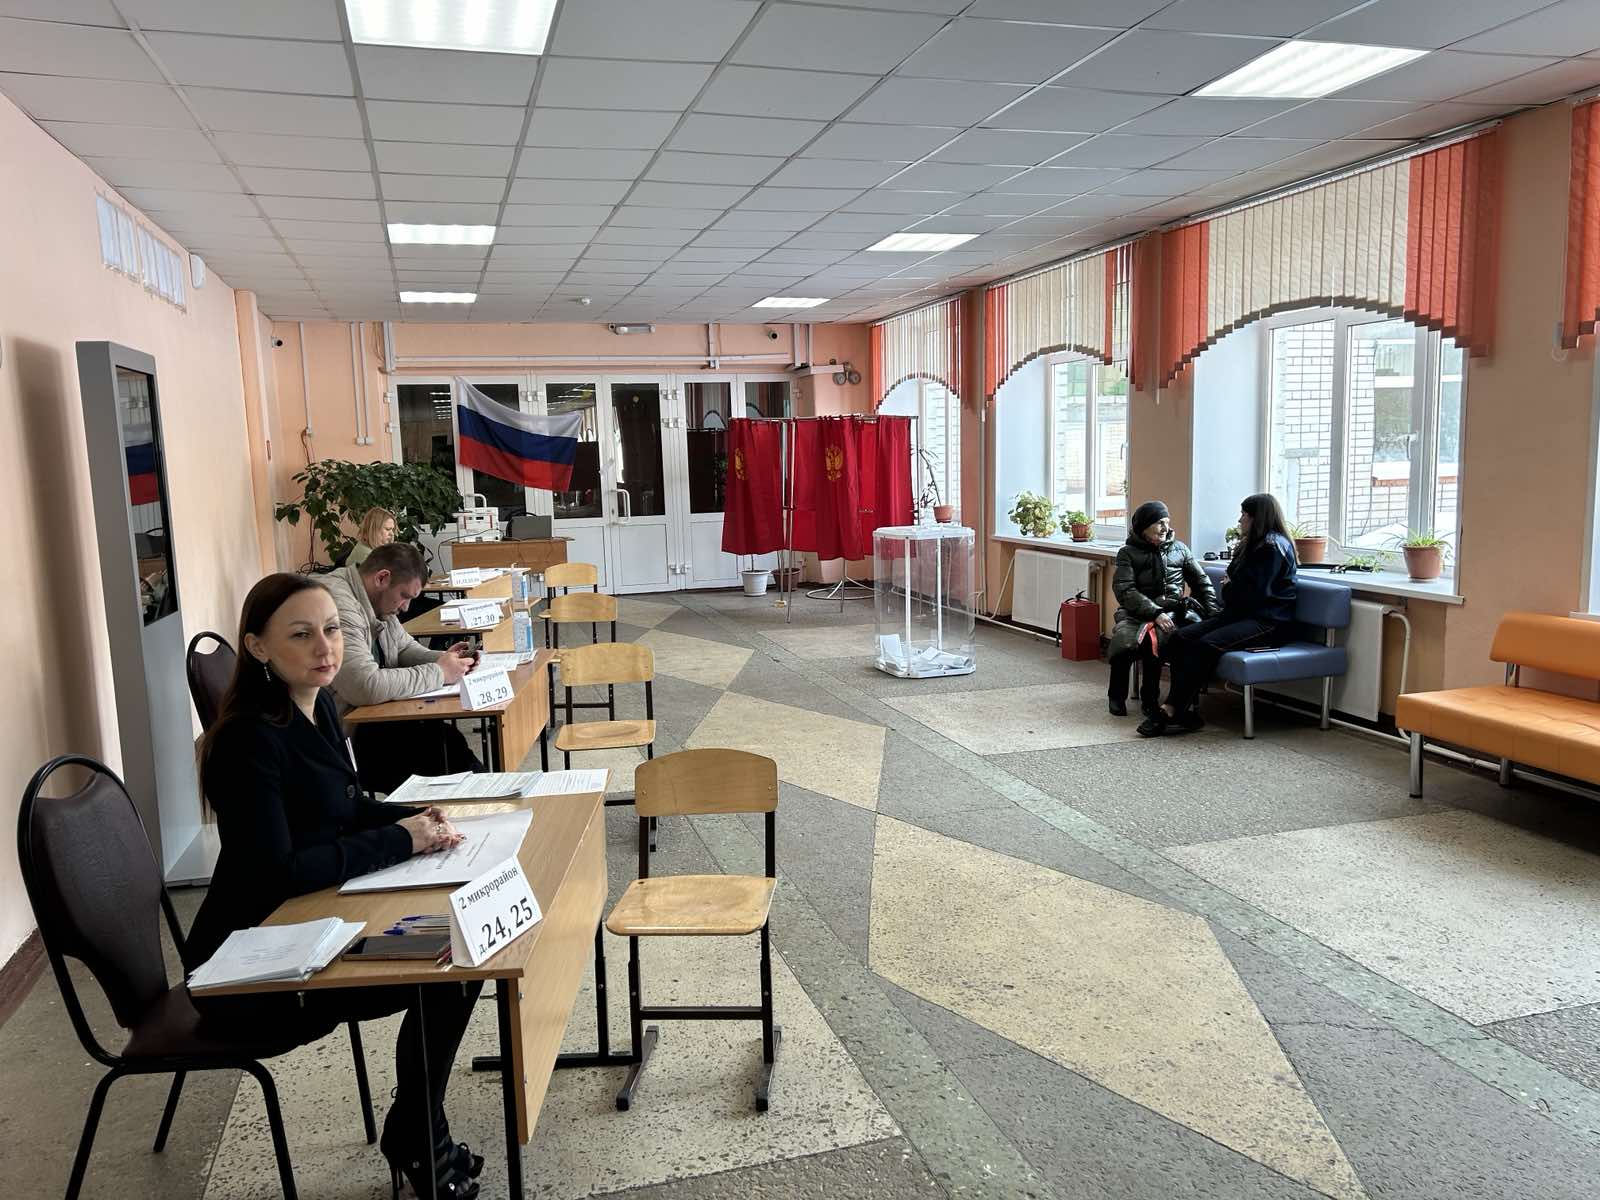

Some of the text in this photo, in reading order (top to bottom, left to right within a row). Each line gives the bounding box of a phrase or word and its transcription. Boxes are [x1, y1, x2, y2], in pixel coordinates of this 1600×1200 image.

[495, 686, 508, 699] 29
[459, 866, 518, 910] 2 микрорайон
[510, 897, 533, 929] 25
